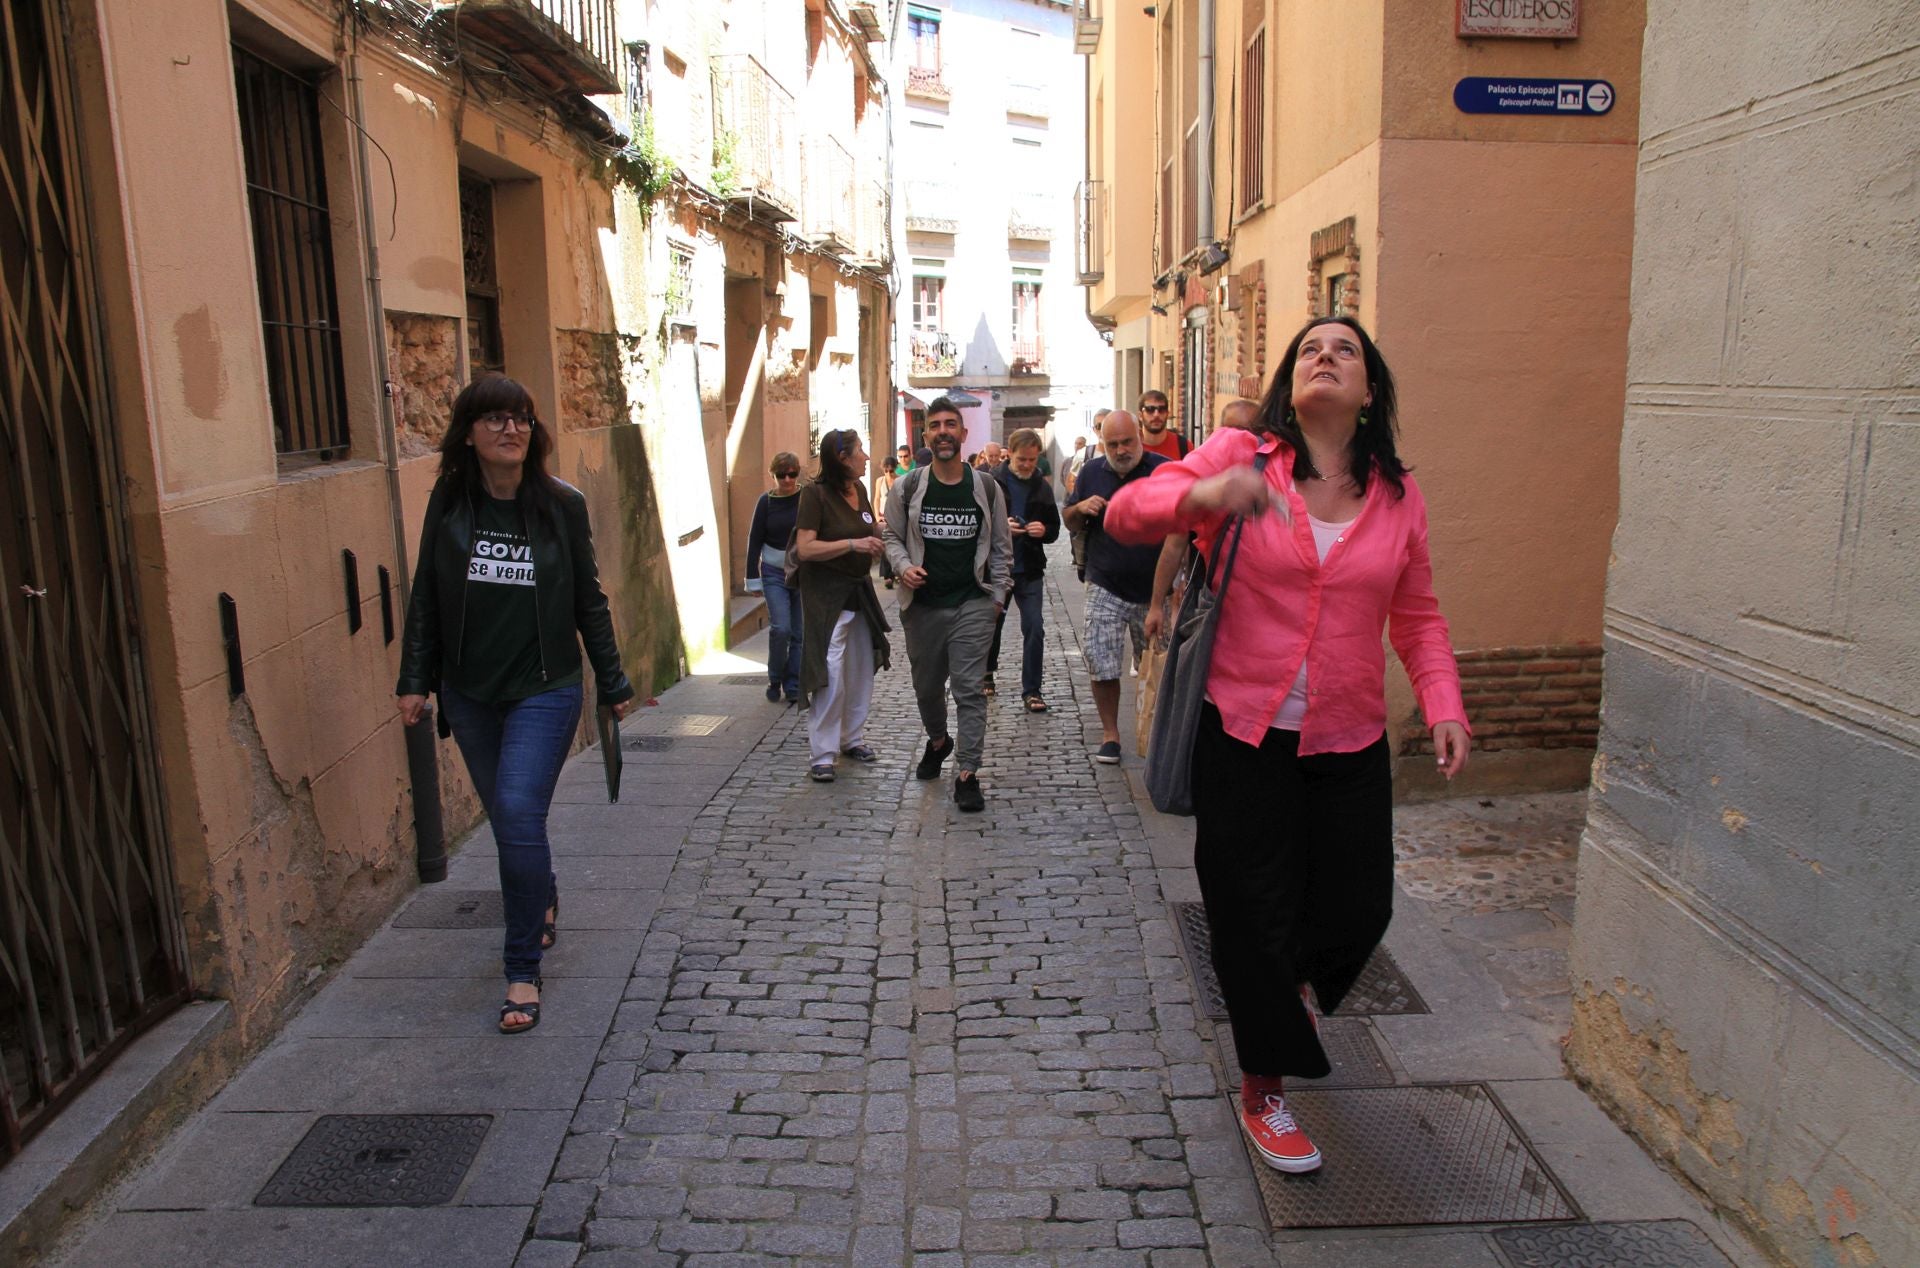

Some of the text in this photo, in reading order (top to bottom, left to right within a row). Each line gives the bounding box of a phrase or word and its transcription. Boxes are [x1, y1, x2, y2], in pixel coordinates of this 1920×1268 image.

[1468, 0, 1571, 21] ESCUDEROS
[1488, 84, 1556, 96] Palacio Episcopal
[1499, 98, 1555, 107] Episcopal Palace
[920, 512, 977, 524] SEGOVIA
[932, 527, 944, 536] se
[474, 540, 533, 560] GOVI
[470, 562, 488, 575] se
